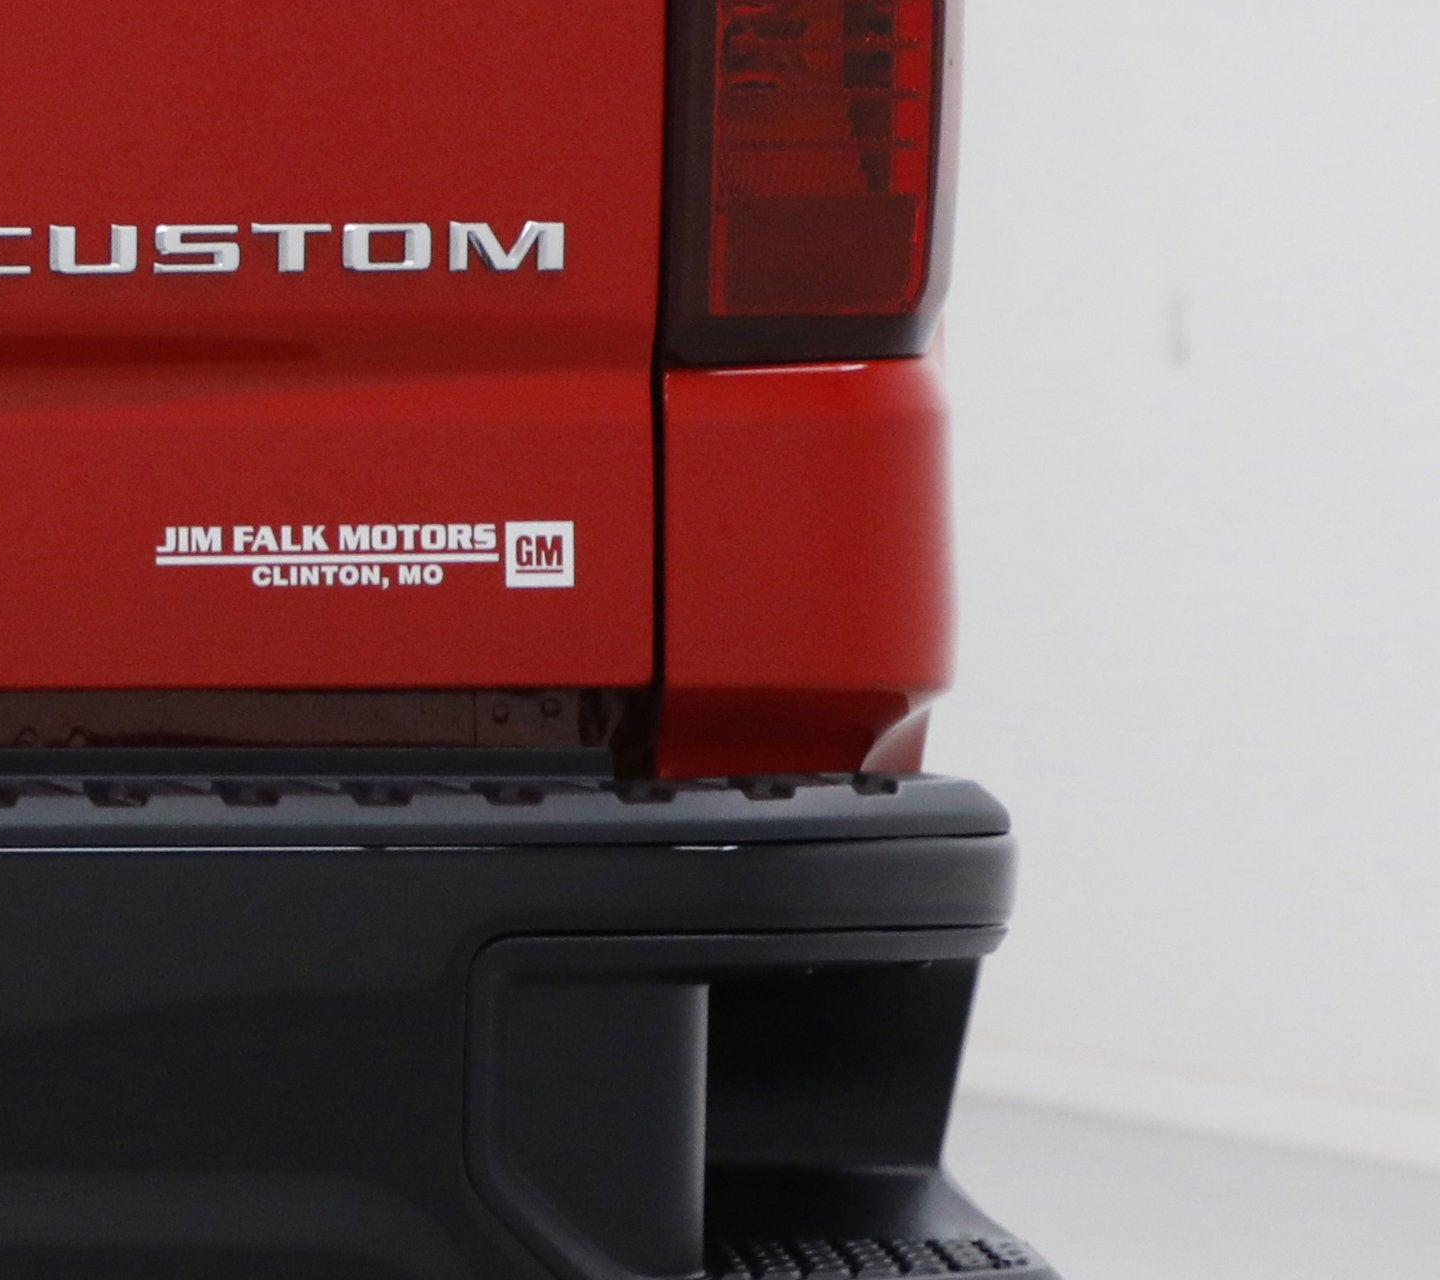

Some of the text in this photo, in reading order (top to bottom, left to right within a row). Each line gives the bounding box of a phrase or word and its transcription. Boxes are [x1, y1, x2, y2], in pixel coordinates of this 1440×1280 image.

[155, 523, 499, 554] JIM FALK MOTORS
[515, 533, 564, 568] GM
[251, 563, 446, 590] CLINTON, MO
